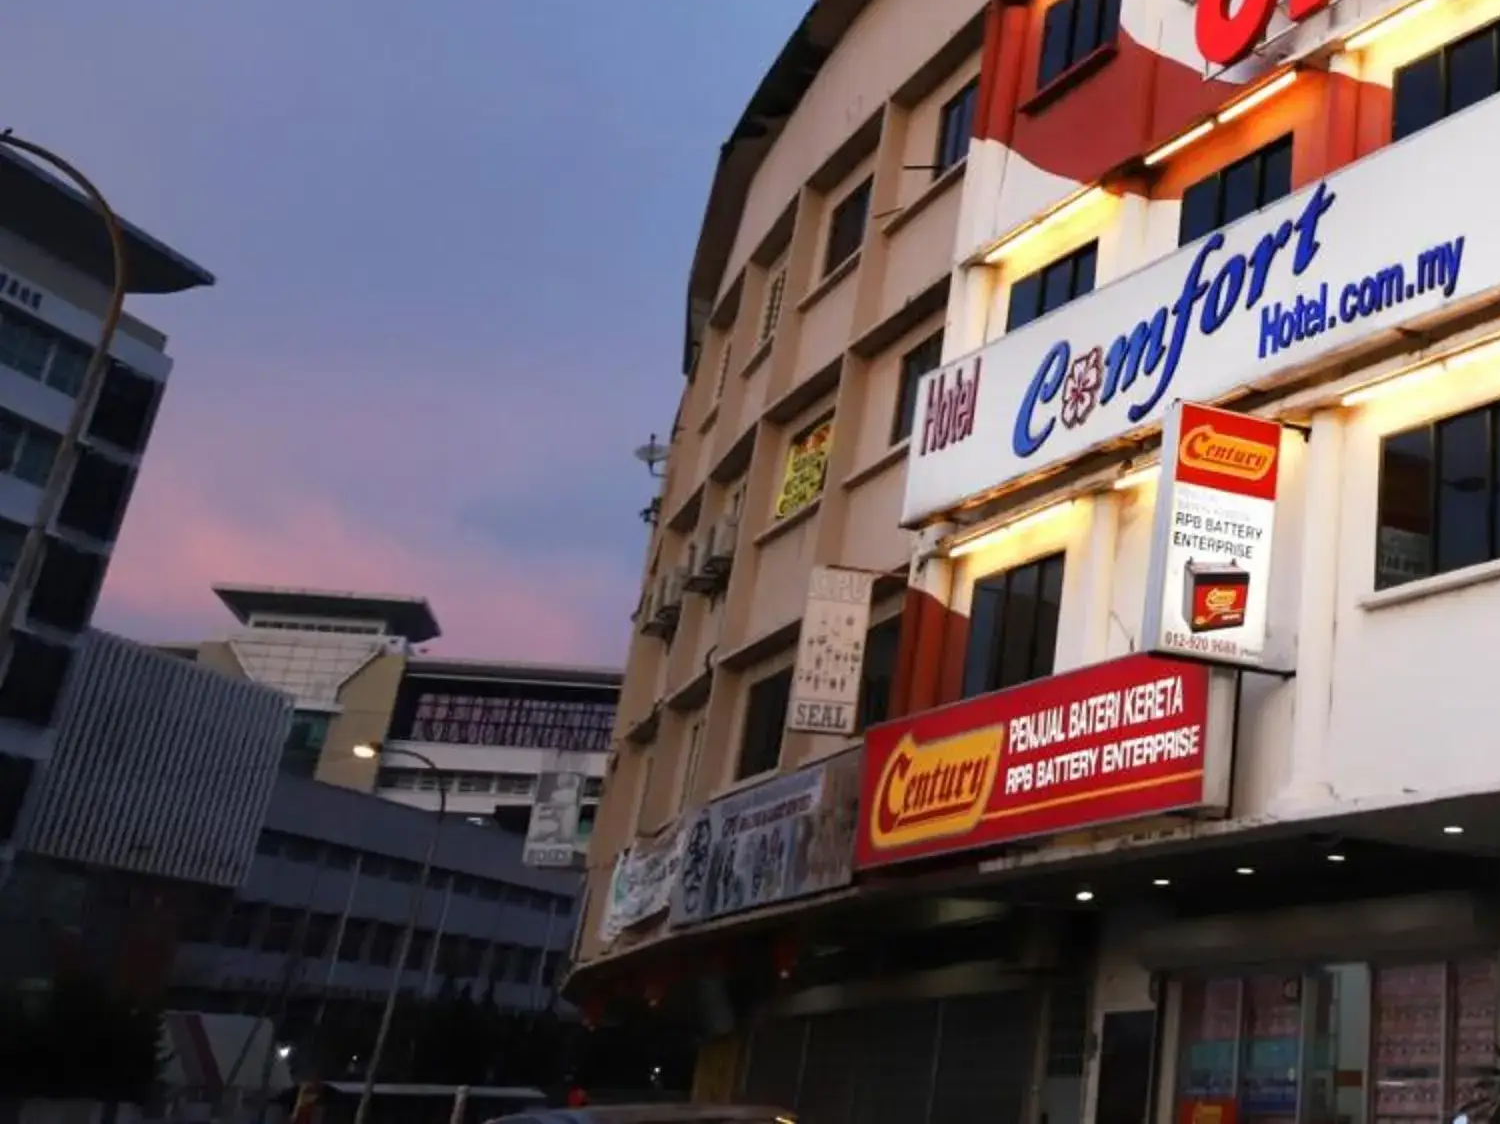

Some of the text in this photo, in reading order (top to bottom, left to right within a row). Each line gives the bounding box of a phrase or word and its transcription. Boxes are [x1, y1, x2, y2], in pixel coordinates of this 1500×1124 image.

[919, 356, 983, 457] Hotel
[1186, 433, 1267, 469] Century
[1173, 531, 1254, 559] ENTERPRISE
[1175, 511, 1263, 540] RPB BATTERY
[795, 704, 848, 729] SEAL
[1008, 676, 1184, 754] PENJUAL BATERI KERETA
[1005, 725, 1201, 795] RPB BATTERY ENTERPRISE
[876, 750, 991, 836] Century
